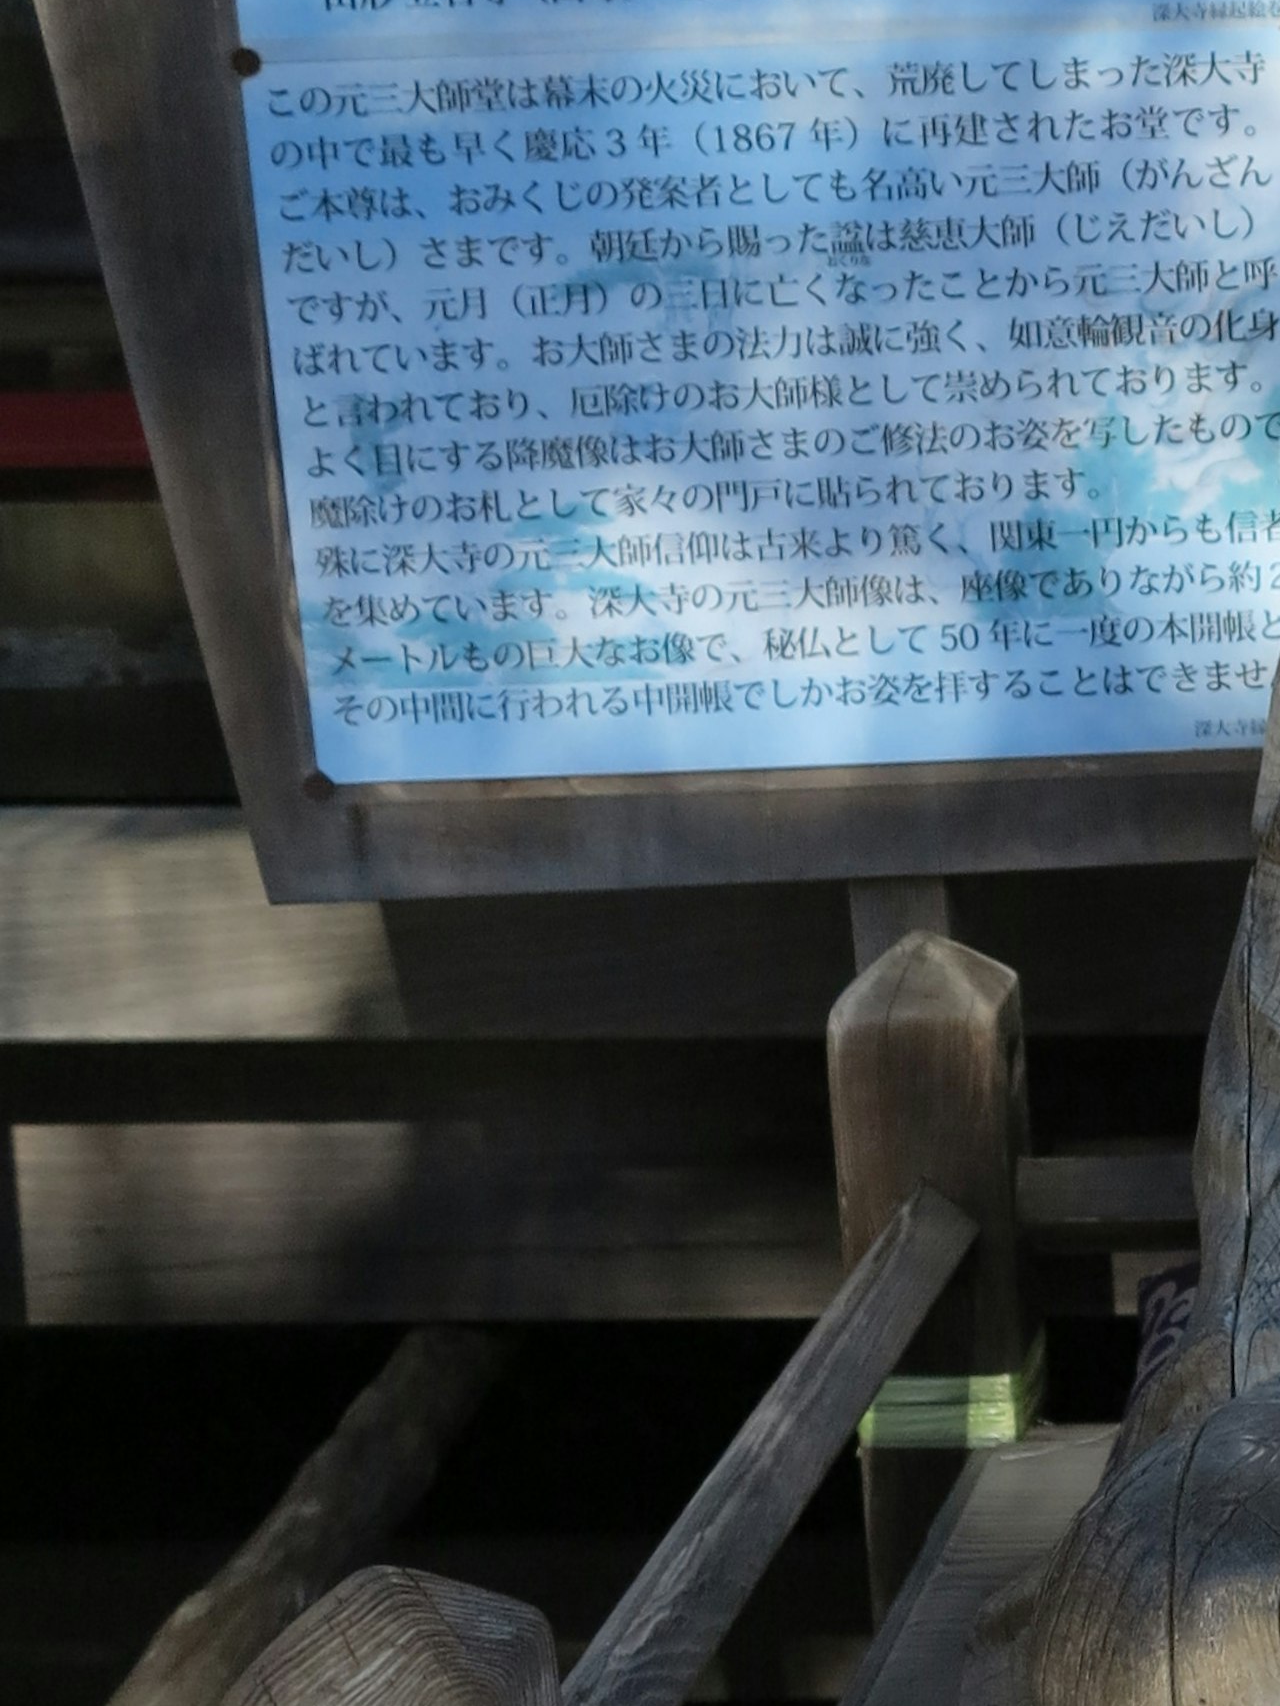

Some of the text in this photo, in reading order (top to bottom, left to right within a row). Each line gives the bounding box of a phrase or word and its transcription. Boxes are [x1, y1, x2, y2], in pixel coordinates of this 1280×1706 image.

[332, 658, 1272, 726] その中間に行われる中開帳でしかお姿を拝することはできませ
